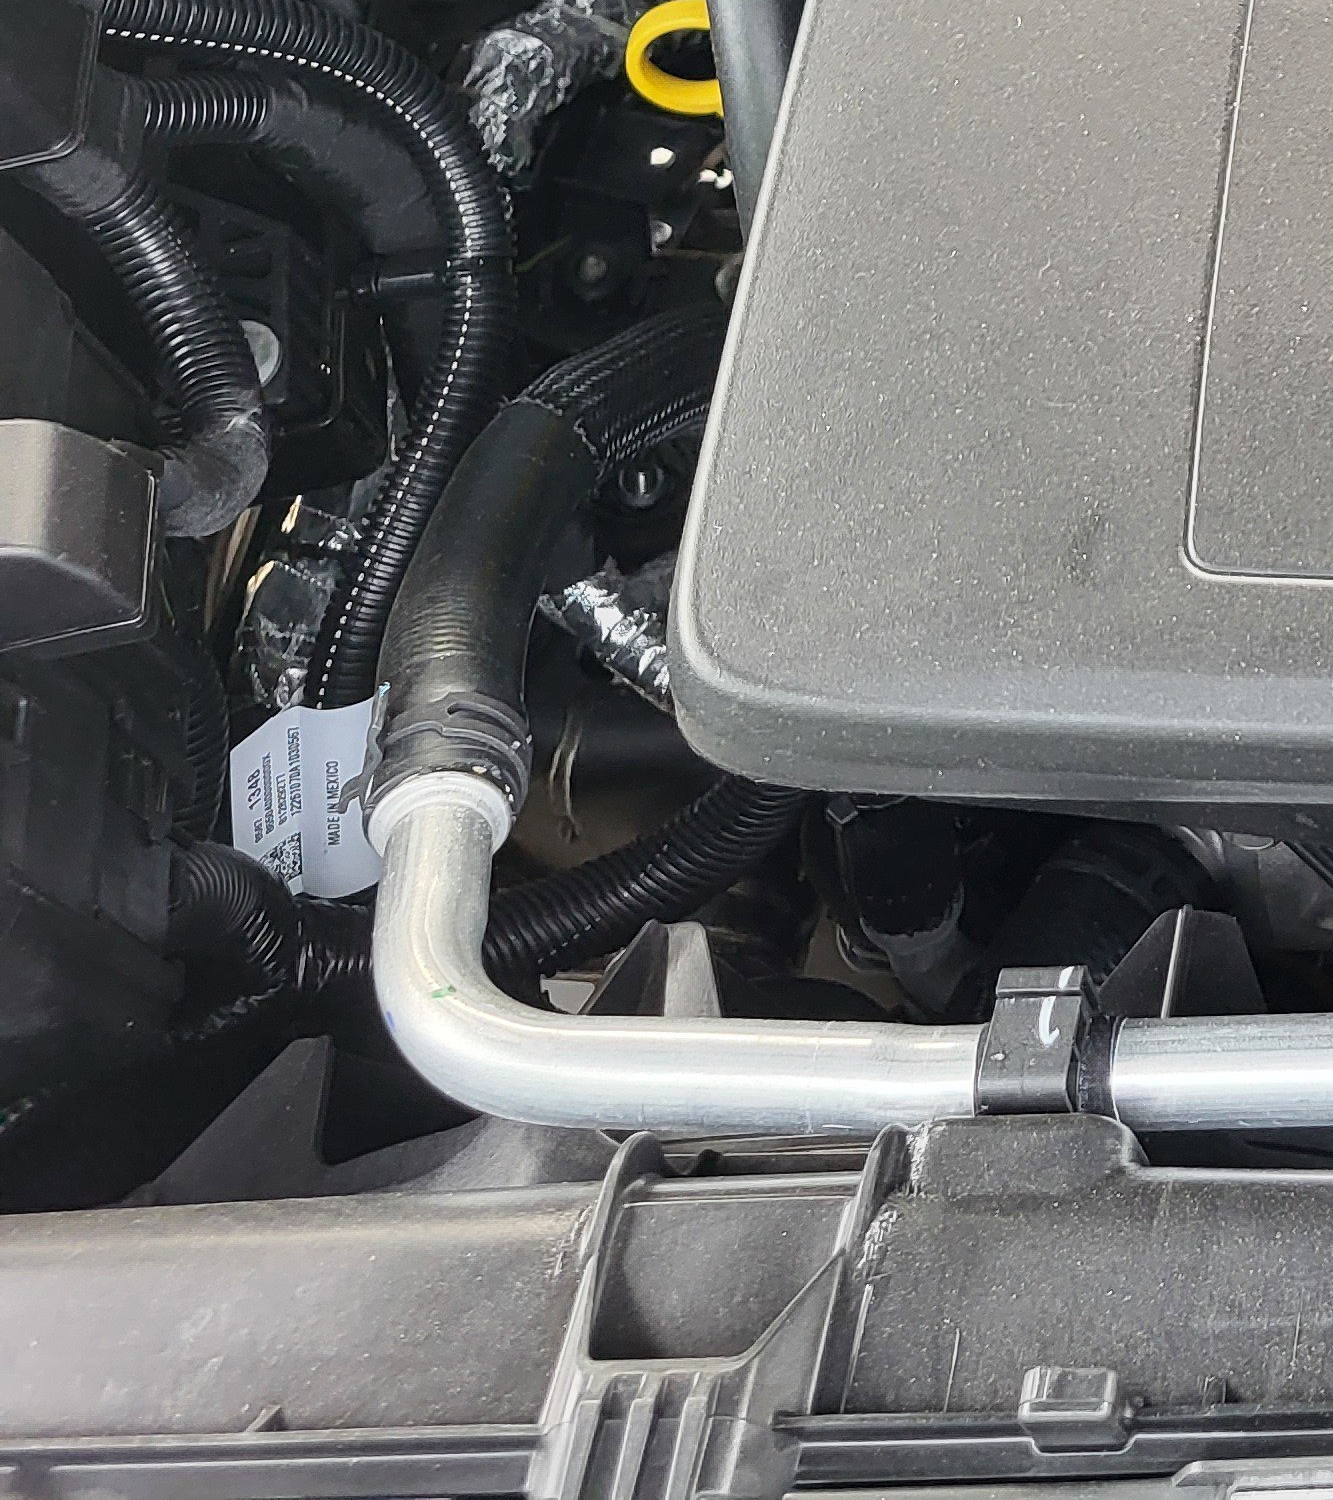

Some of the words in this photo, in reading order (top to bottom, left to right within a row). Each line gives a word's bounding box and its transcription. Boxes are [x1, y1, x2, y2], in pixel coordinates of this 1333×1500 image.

[247, 768, 262, 811] 1348
[325, 760, 340, 799] MEXICO
[327, 816, 341, 846] MADE
